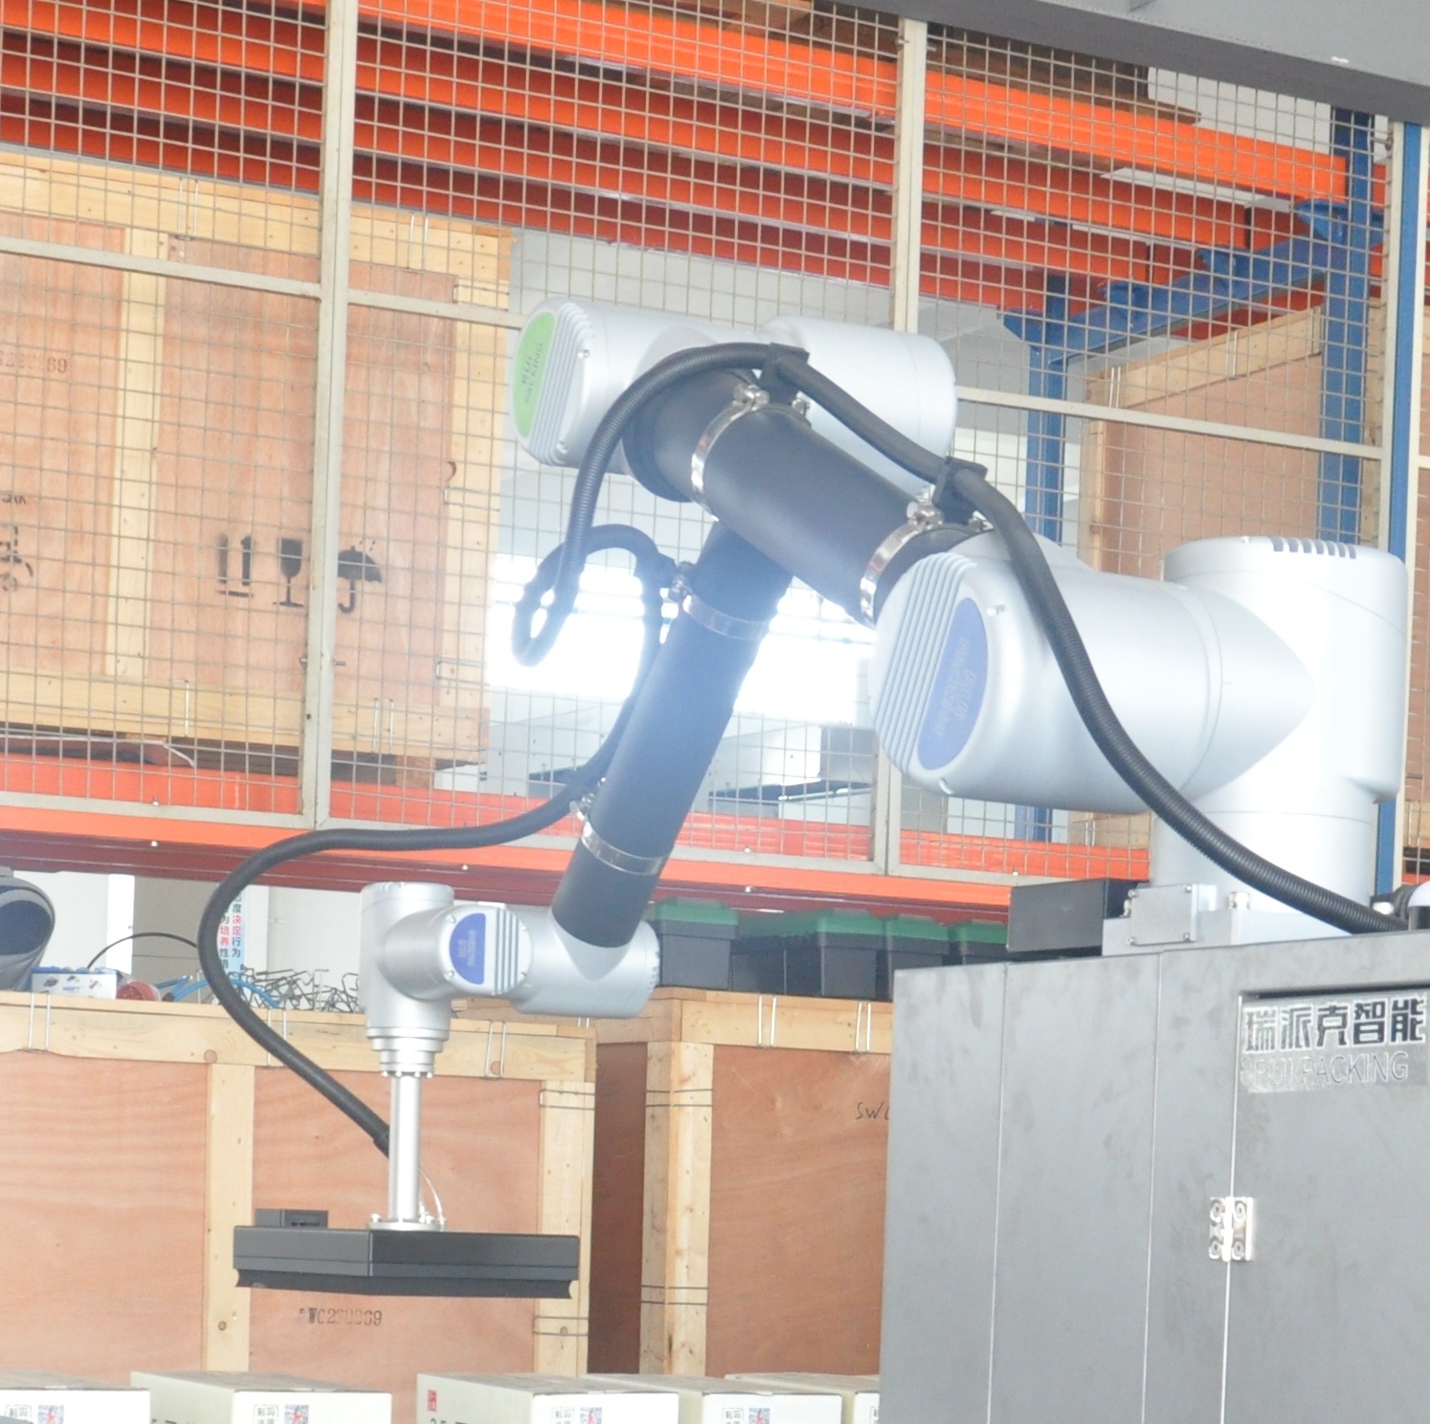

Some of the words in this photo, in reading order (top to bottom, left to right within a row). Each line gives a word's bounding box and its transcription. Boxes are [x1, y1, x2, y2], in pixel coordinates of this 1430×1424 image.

[1244, 996, 1426, 1053] 瑞派克智能
